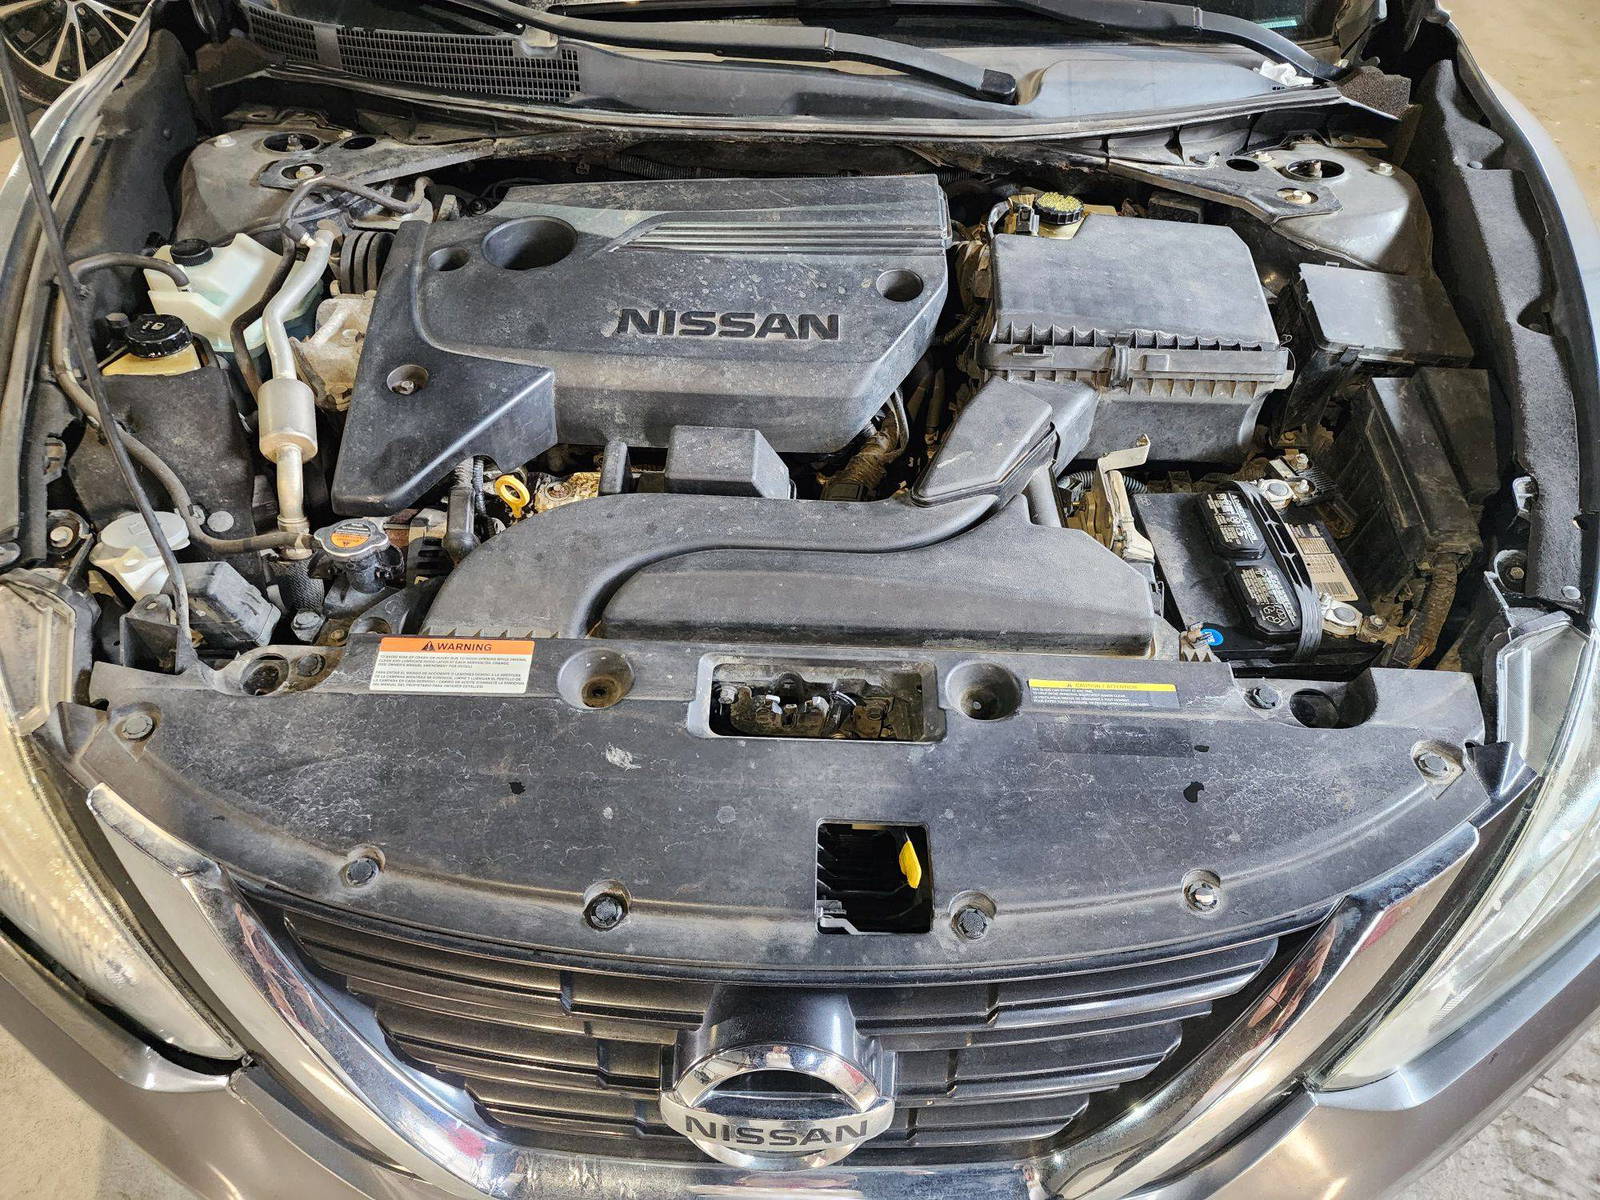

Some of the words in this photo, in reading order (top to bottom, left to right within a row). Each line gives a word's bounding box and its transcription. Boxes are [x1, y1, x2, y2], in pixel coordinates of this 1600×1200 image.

[616, 308, 840, 341] NISSAN
[437, 642, 492, 652] WARNING
[685, 1115, 868, 1146] NISSAN
